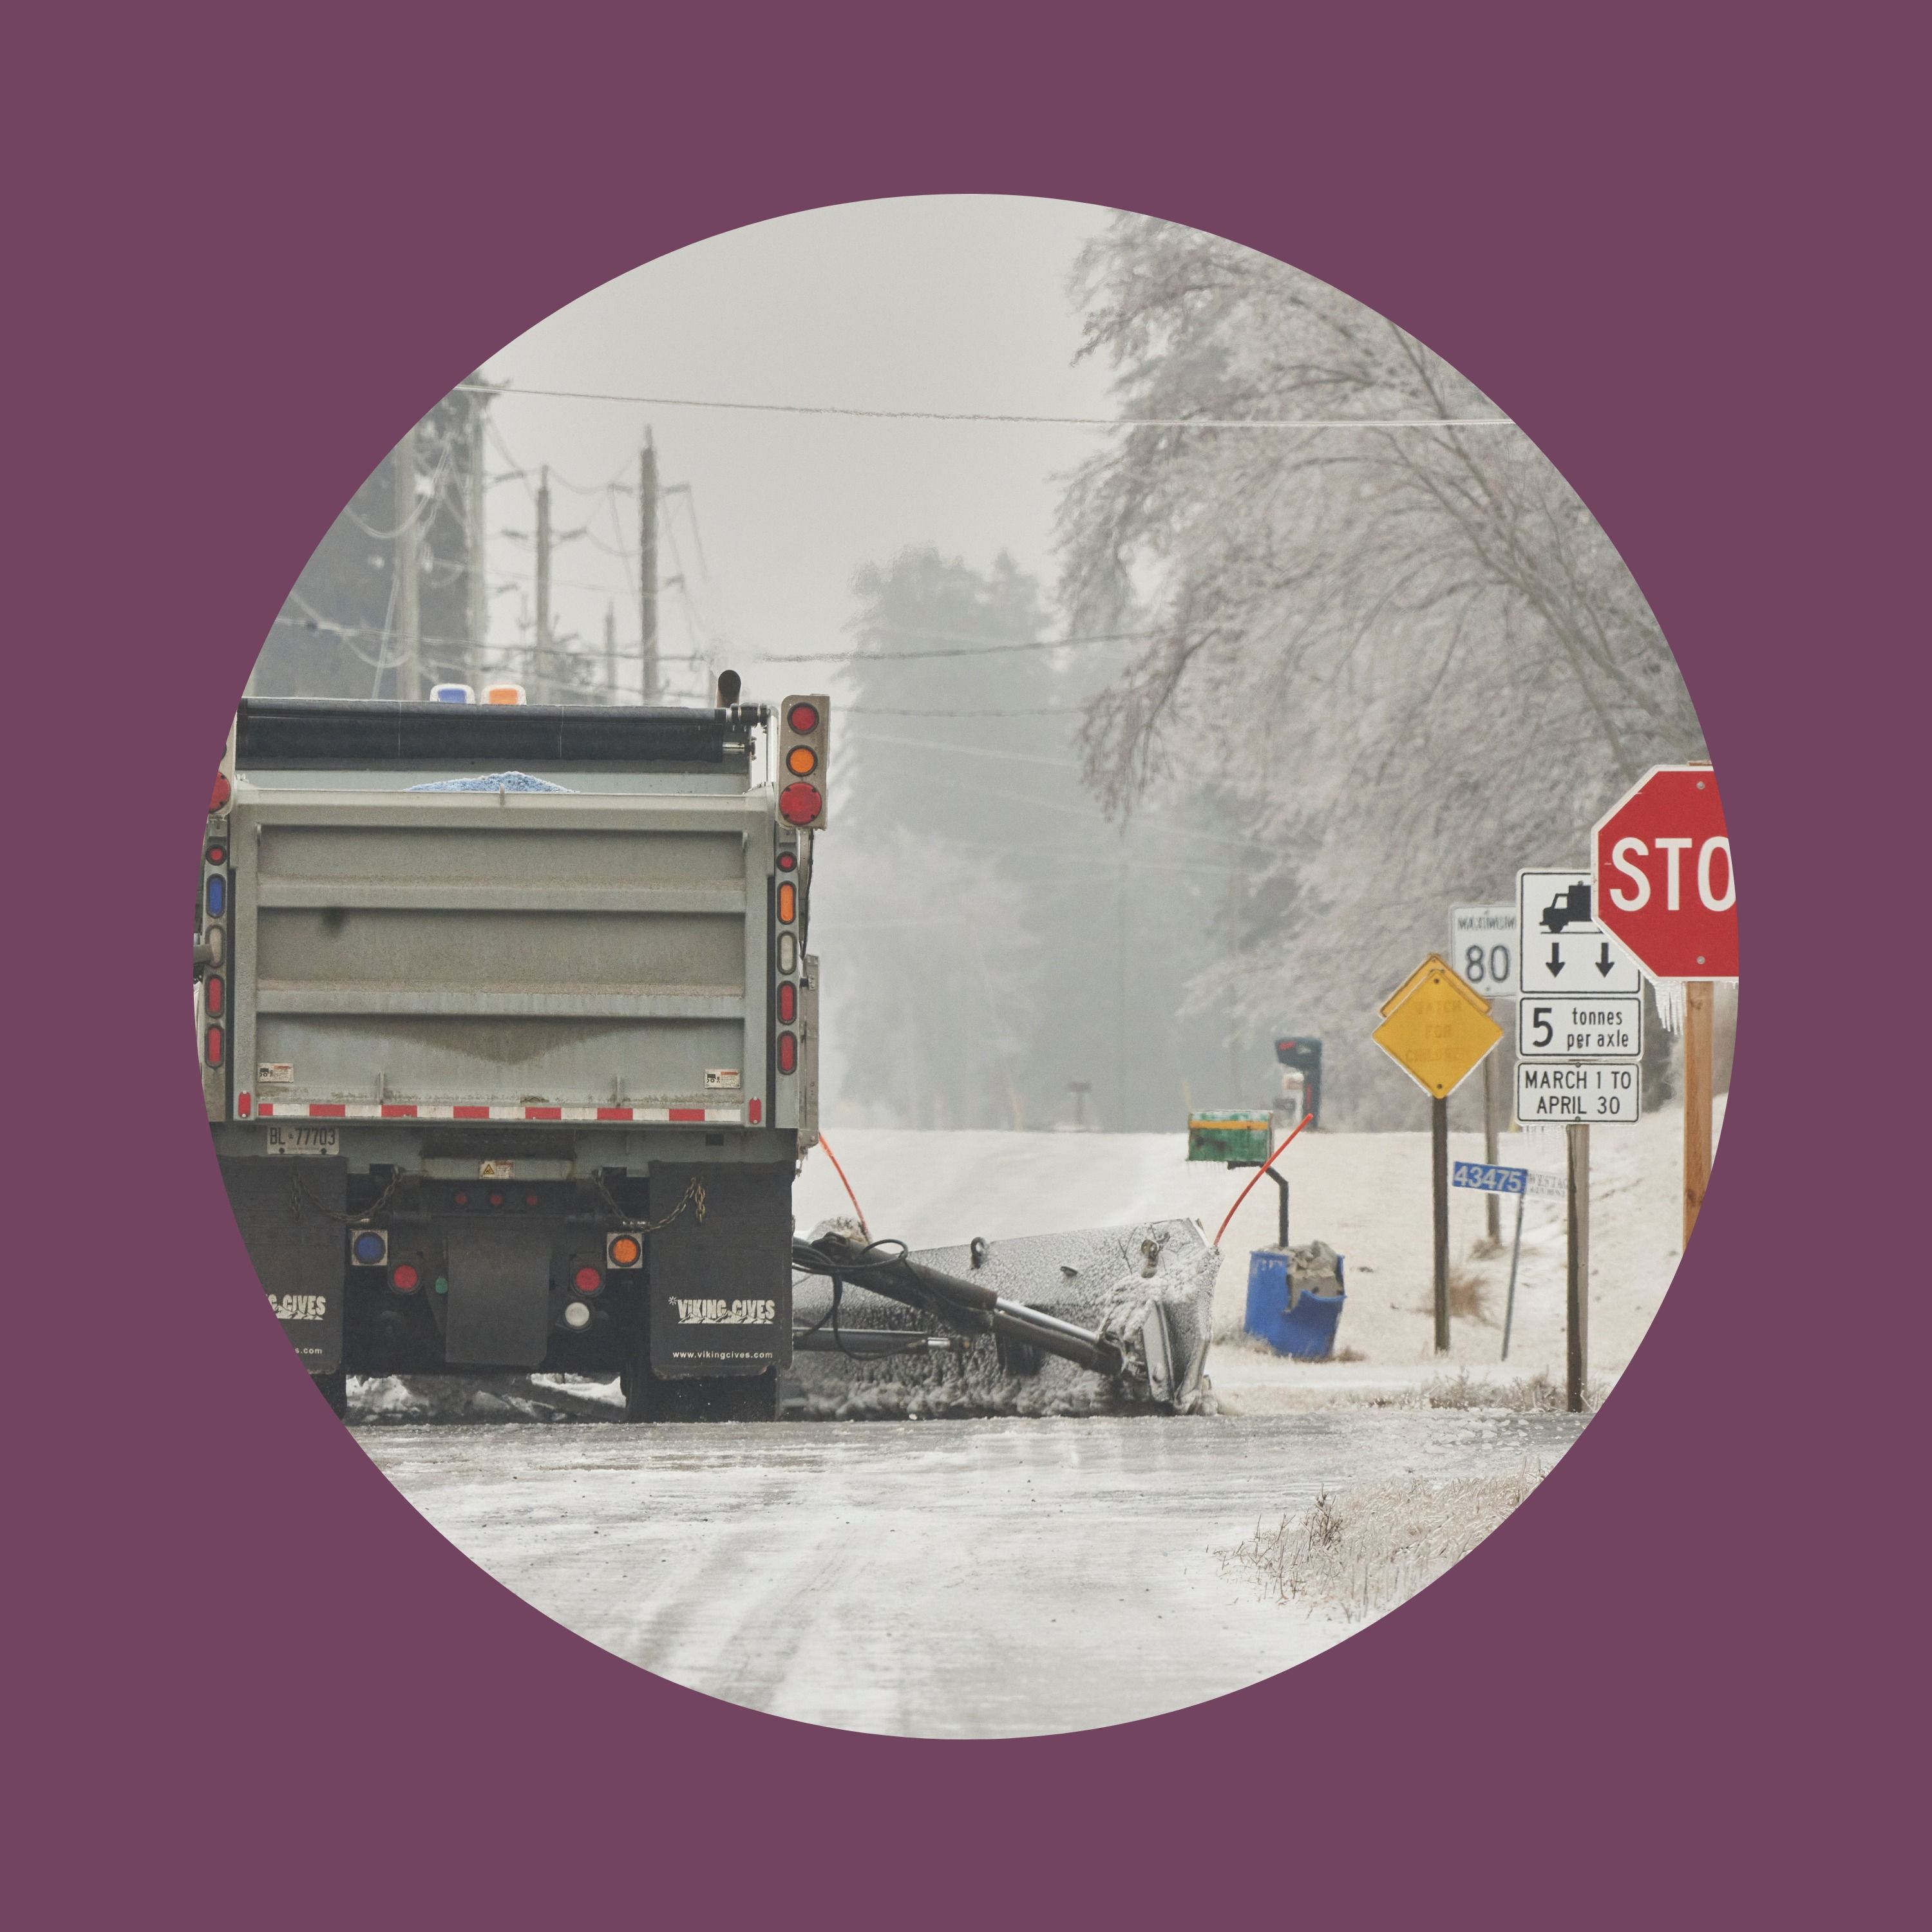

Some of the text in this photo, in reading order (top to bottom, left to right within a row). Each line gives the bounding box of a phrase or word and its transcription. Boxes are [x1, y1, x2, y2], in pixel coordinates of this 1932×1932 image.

[1610, 836, 1736, 911] STO
[1457, 916, 1516, 931] MAXIMUM
[1466, 944, 1511, 983] 80
[1572, 1007, 1623, 1025] tonnes
[1425, 1025, 1452, 1039] FOR
[1532, 1007, 1553, 1047] 5
[1567, 1029, 1629, 1051] per axle
[1525, 1071, 1632, 1090] MARCH 1 TO
[1537, 1096, 1620, 1115] APRIL 30
[270, 1127, 335, 1145] BL 77703
[1455, 1166, 1522, 1192] 43475
[677, 1299, 726, 1319] VIKING
[673, 1350, 772, 1359] www.vikingcives.com
